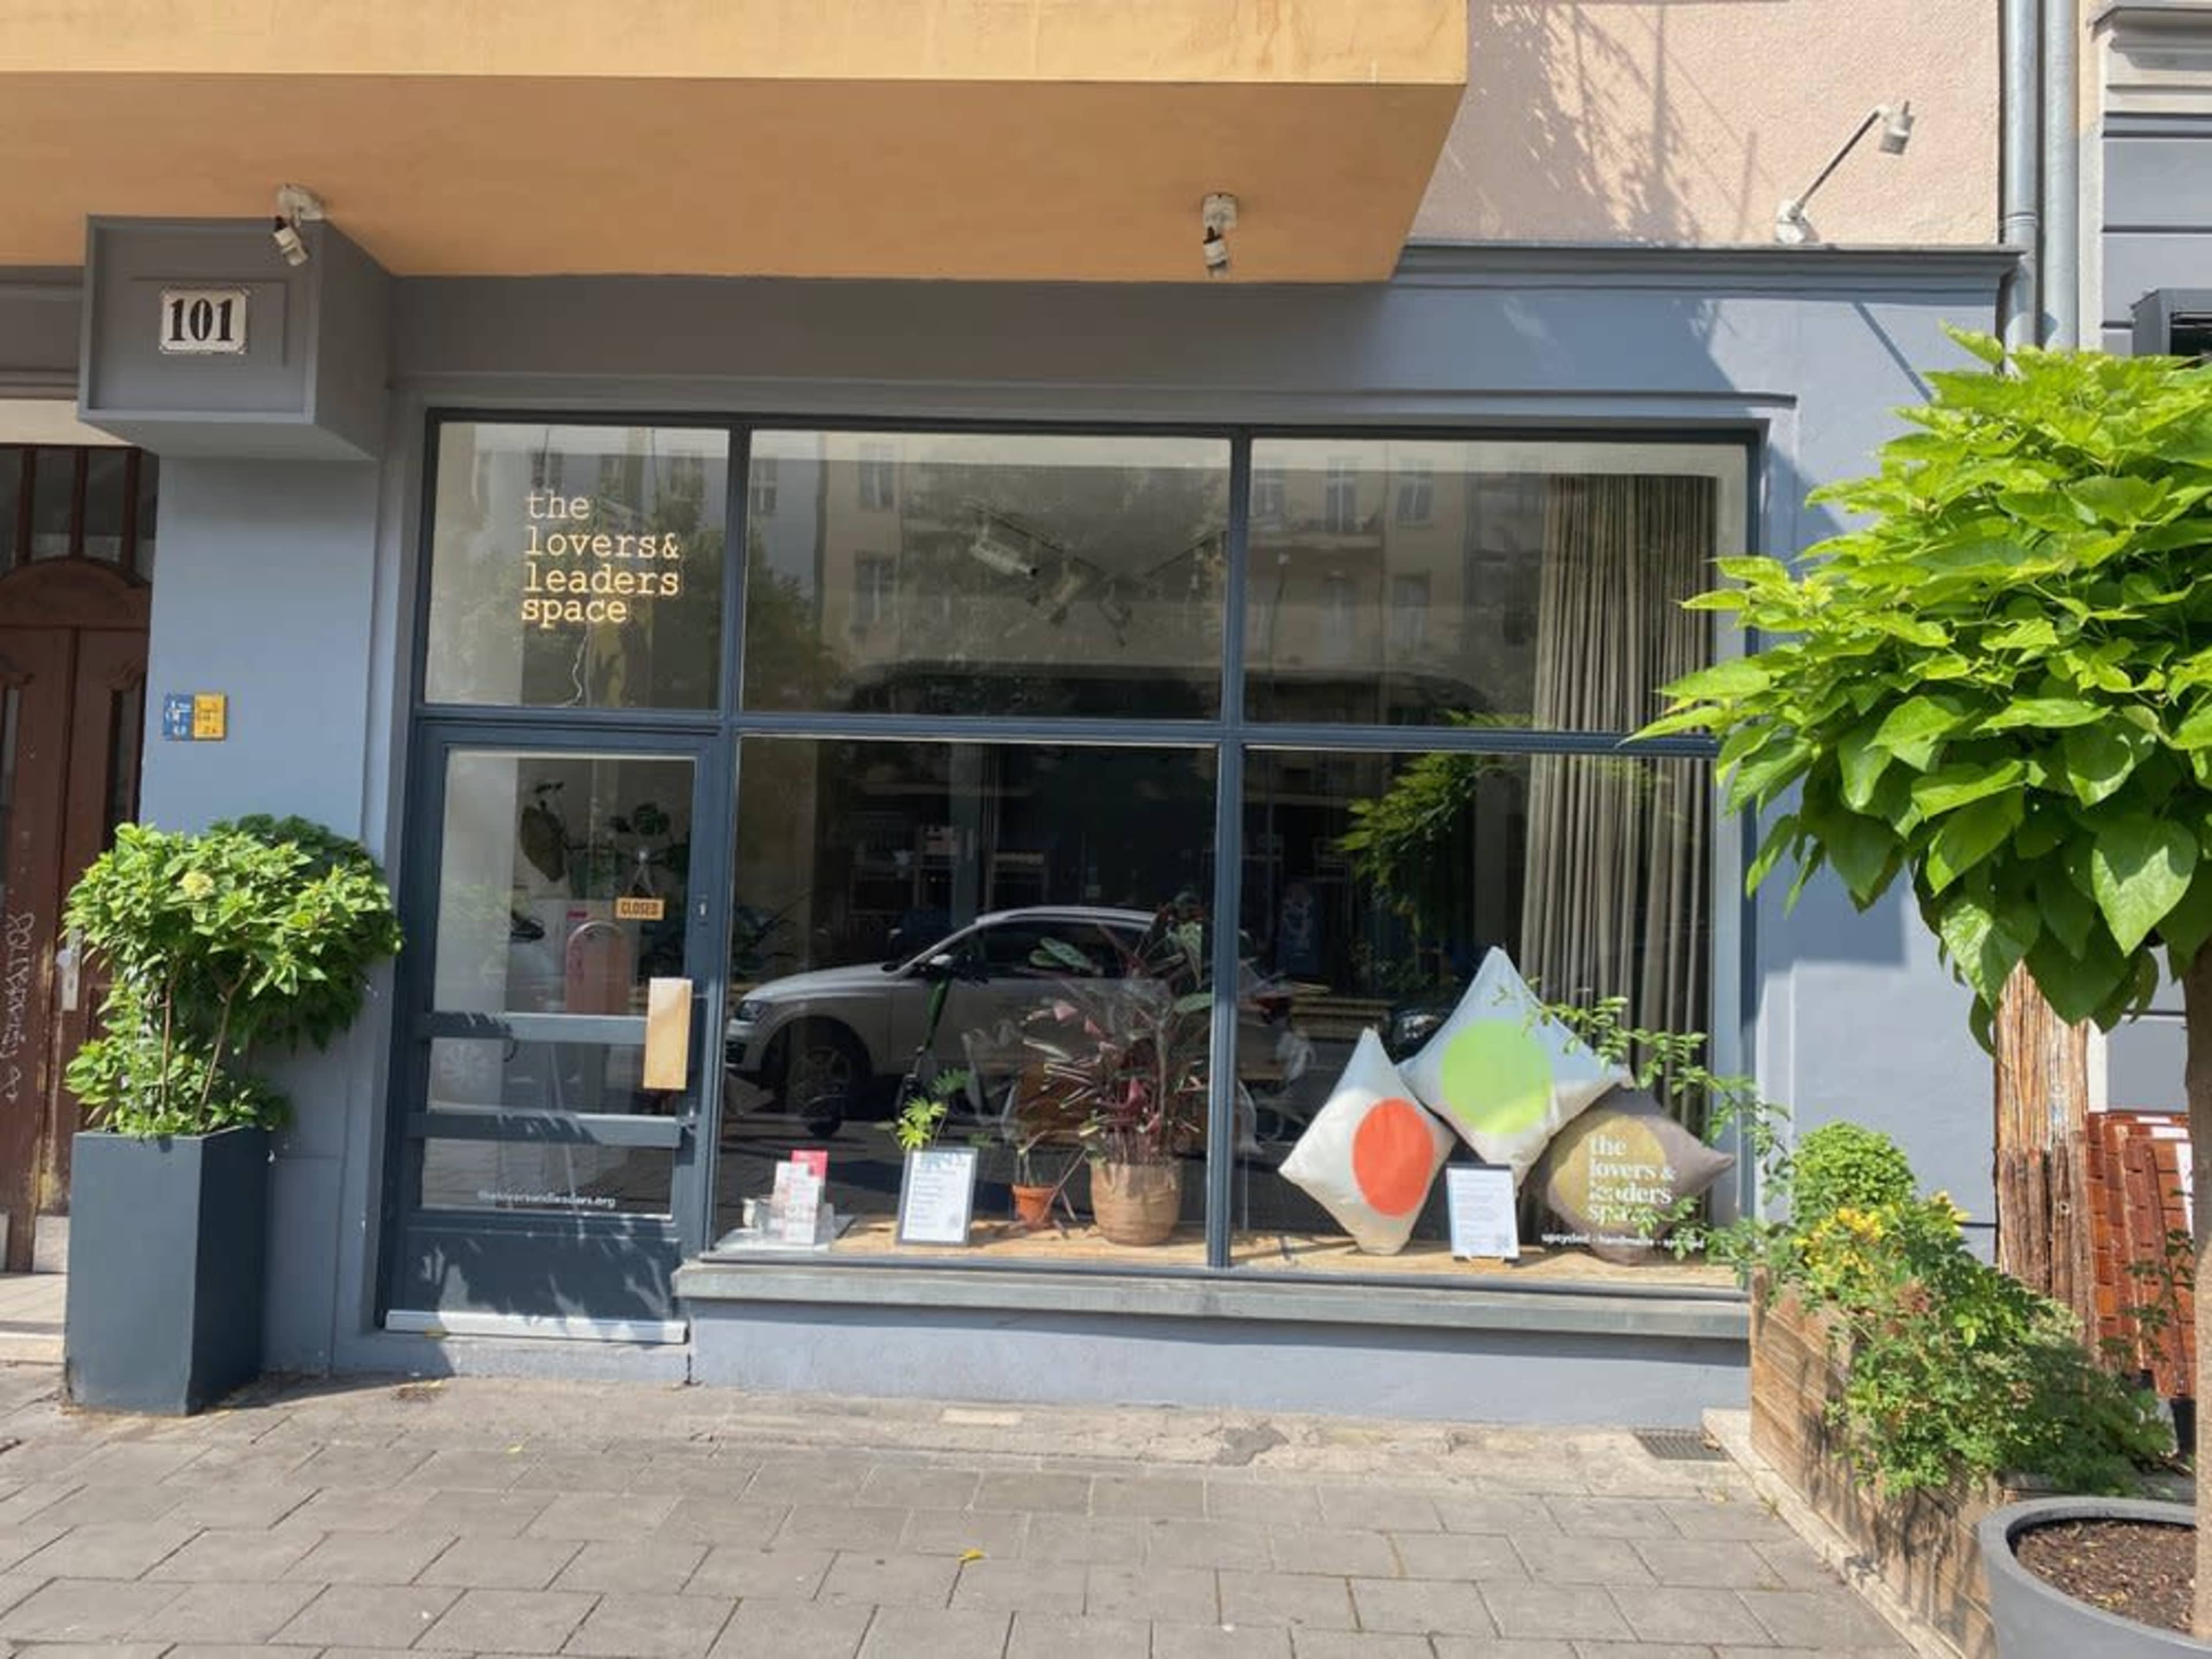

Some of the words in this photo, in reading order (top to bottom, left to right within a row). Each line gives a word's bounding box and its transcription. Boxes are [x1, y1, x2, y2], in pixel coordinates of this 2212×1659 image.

[169, 298, 233, 341] 101
[525, 489, 590, 520] the
[524, 525, 680, 559] lovers&
[524, 561, 679, 596] leaders
[521, 597, 627, 629] space
[622, 902, 659, 916] CLOSED
[1589, 1134, 1627, 1156] the
[1589, 1156, 1657, 1180] lovers
[1661, 1166, 1676, 1181] &
[1589, 1179, 1673, 1205] leaders
